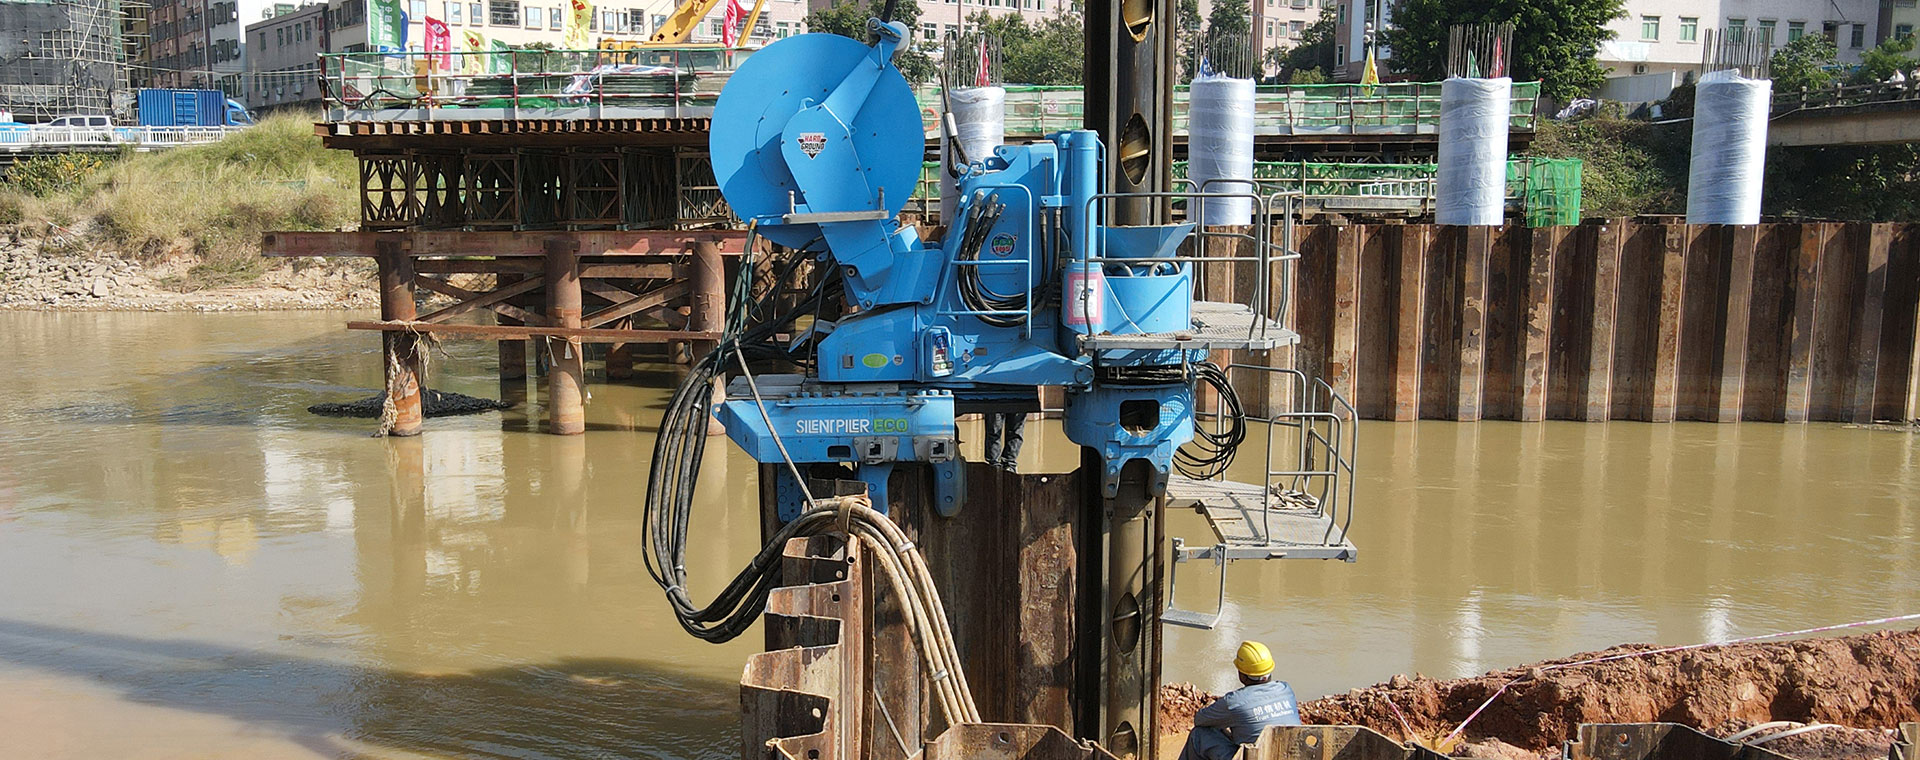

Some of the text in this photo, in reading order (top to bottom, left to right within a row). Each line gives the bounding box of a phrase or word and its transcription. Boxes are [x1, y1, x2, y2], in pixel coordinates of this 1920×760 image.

[795, 418, 908, 434] SILENT PILER ECO
